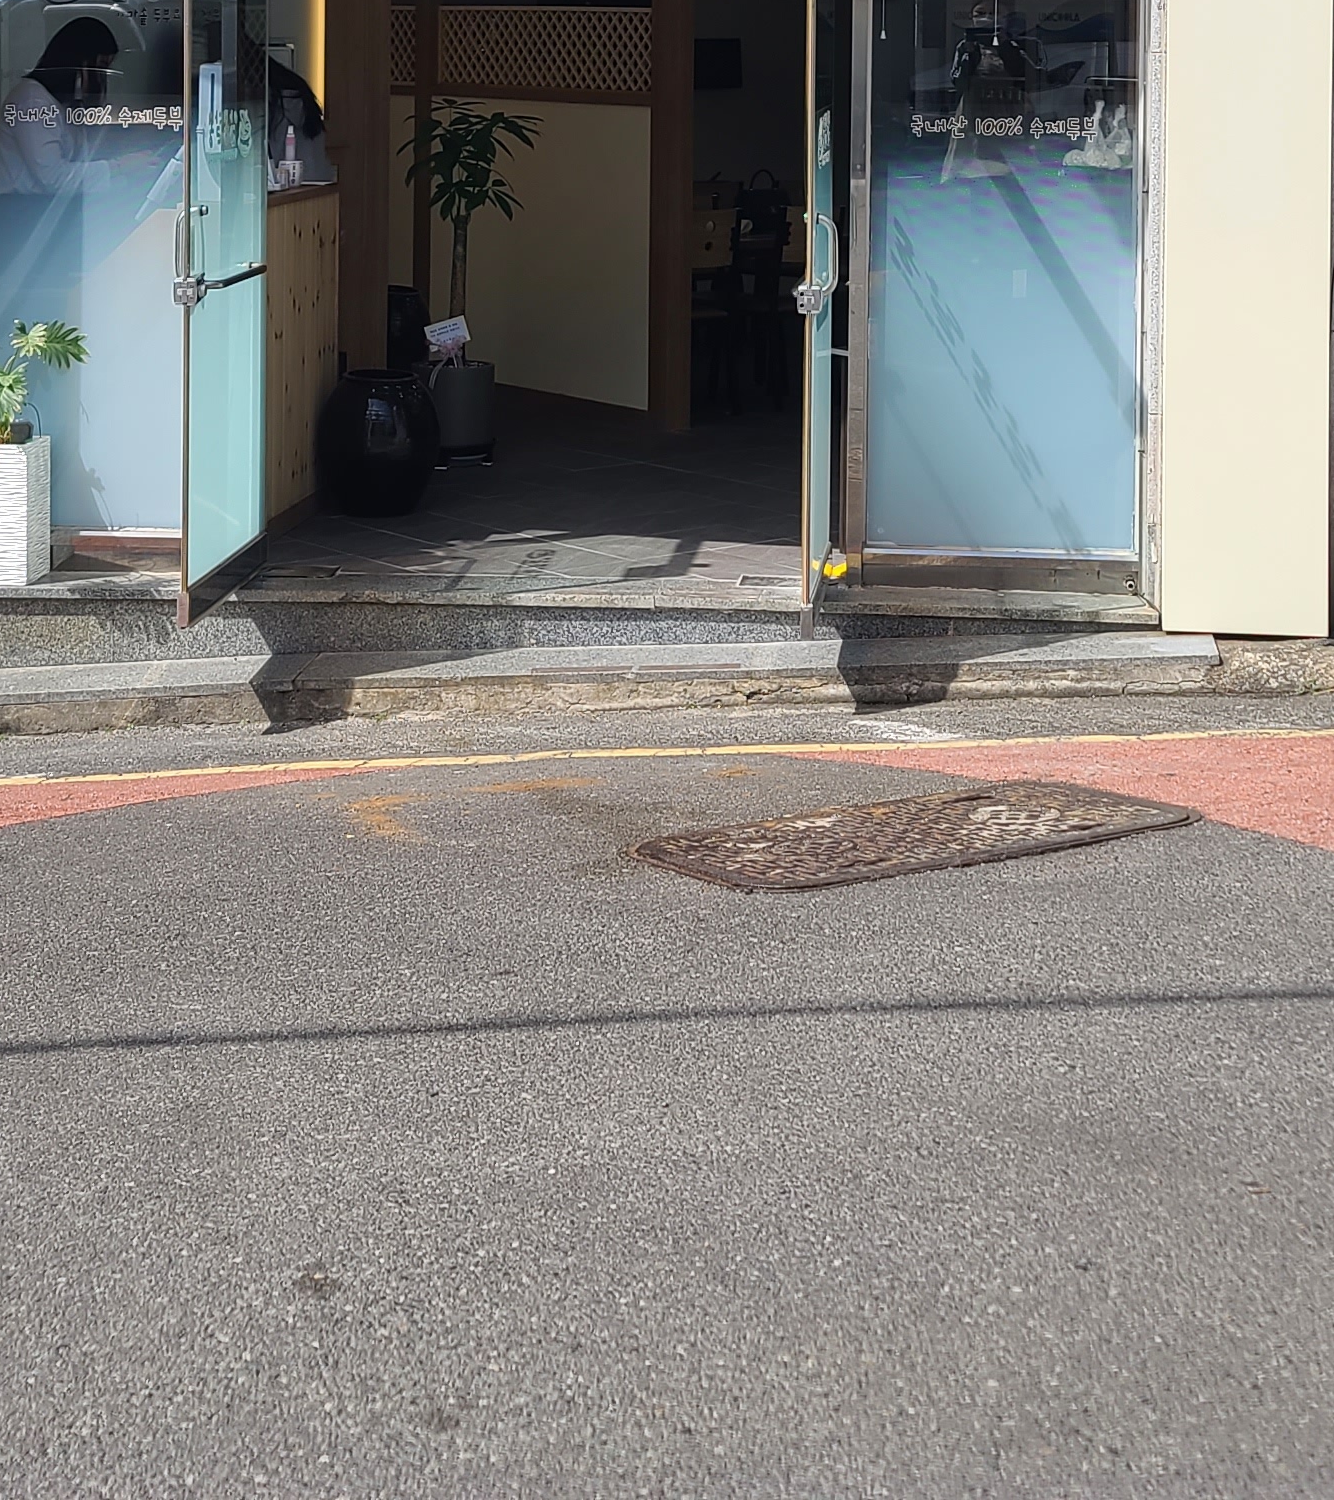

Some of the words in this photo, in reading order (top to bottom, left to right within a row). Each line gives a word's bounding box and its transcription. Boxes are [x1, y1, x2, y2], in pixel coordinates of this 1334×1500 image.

[3, 104, 60, 128] 국내산
[66, 105, 113, 126] 100%
[117, 105, 184, 132] 수제두부
[910, 114, 968, 139] 국내산
[975, 115, 1023, 137] 100%
[1029, 116, 1098, 143] 수제두부
